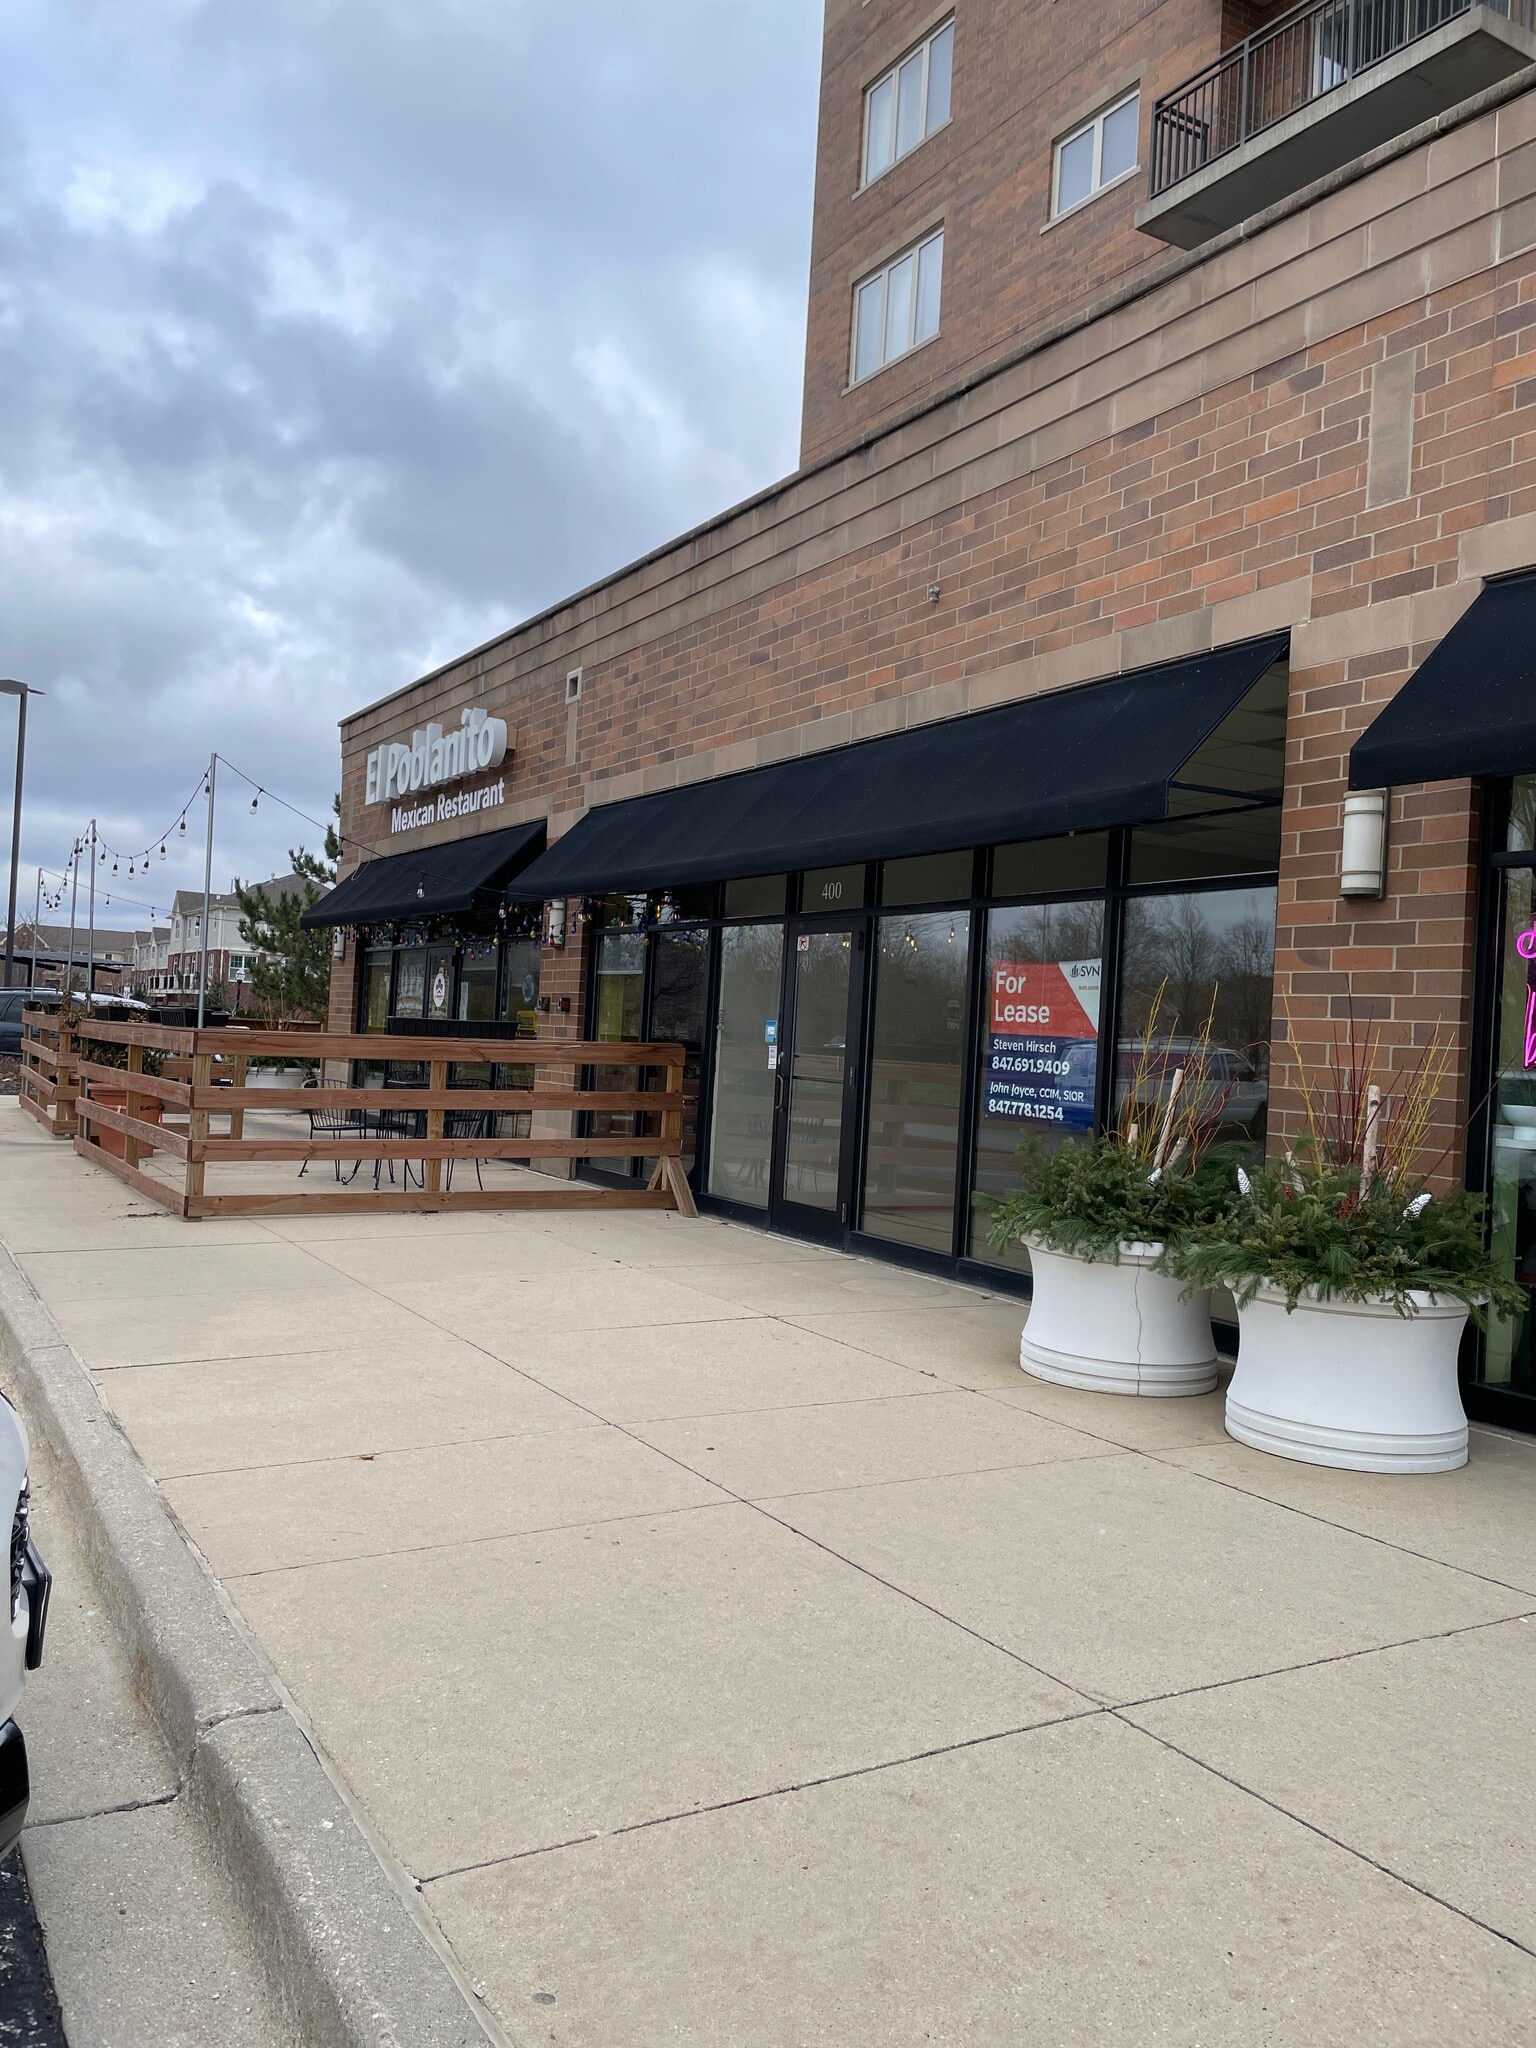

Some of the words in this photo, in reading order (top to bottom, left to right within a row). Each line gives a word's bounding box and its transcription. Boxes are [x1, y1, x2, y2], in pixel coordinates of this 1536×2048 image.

[365, 744, 389, 805] El
[385, 707, 508, 800] Poblanito
[391, 801, 435, 834] Mexican
[436, 777, 506, 822] Restaurant
[822, 882, 842, 899] 400
[1080, 965, 1100, 977] SVN
[995, 971, 1026, 993] For
[995, 1000, 1050, 1023] Lease
[993, 1038, 1024, 1052] Steven
[1025, 1040, 1057, 1054] Hirsch
[991, 1056, 1070, 1075] 847.691.9409
[989, 1081, 1010, 1095] John
[1011, 1083, 1038, 1099] Joyce,
[1039, 1087, 1062, 1101] CCIM,
[1063, 1090, 1085, 1103] SIOR
[988, 1099, 1064, 1120] 847.778.1254
